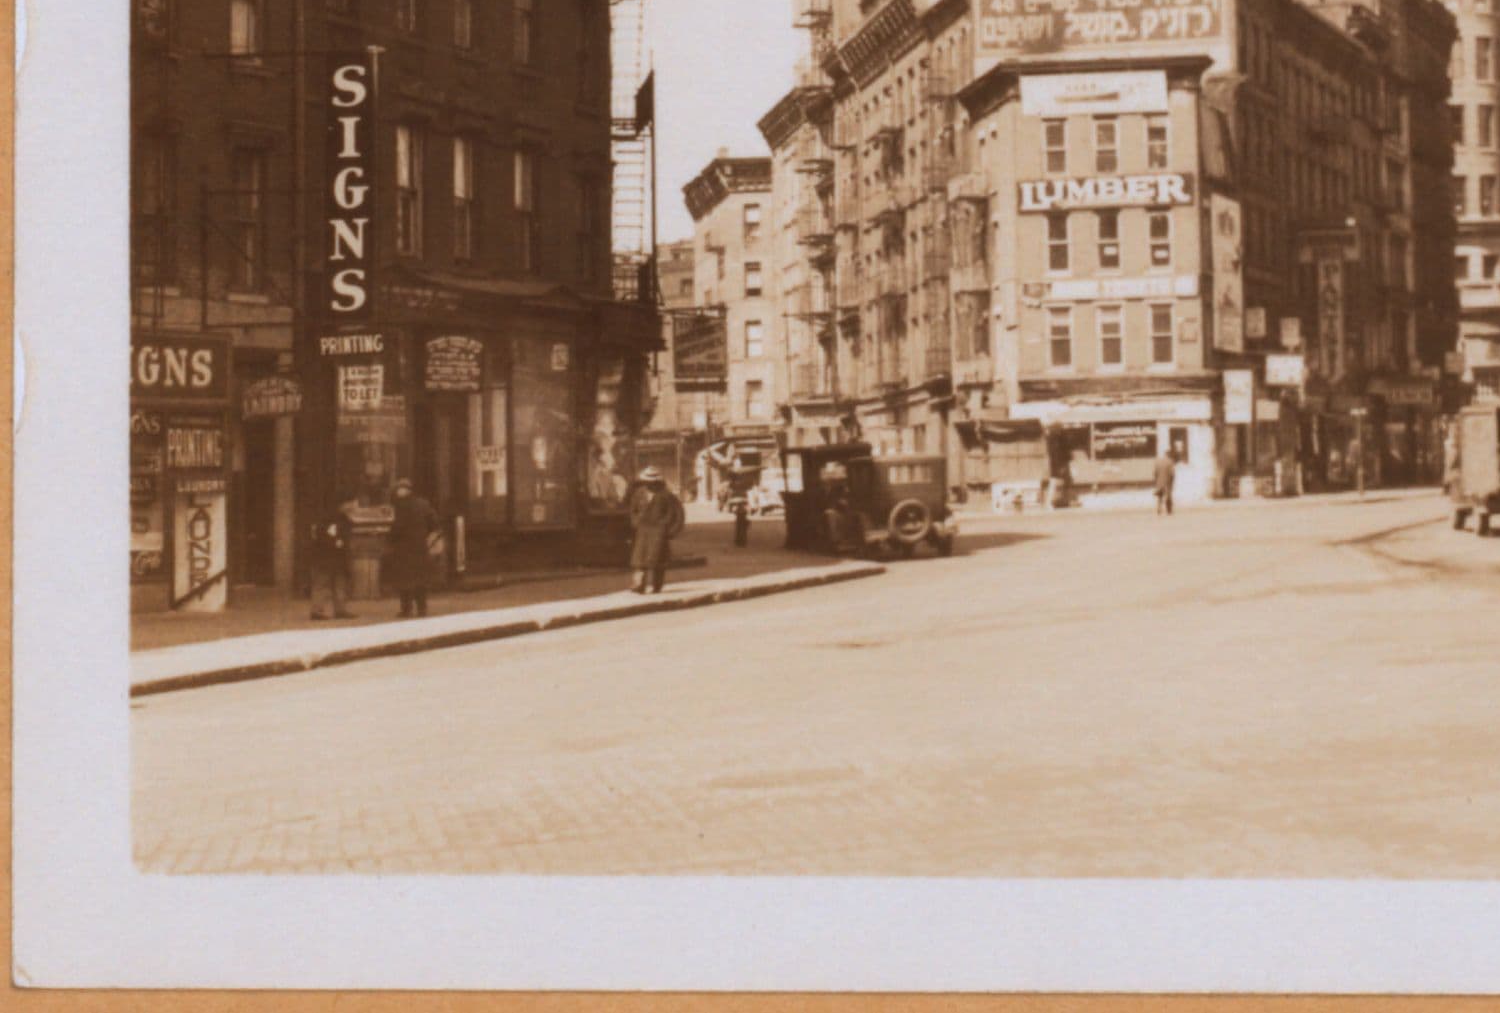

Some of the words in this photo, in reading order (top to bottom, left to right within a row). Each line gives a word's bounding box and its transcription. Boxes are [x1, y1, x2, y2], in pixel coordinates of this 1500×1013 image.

[330, 65, 369, 312] SIGNS
[1021, 174, 1189, 209] LUMBER
[320, 334, 384, 356] PRINTING
[131, 347, 212, 387] GNS
[168, 428, 223, 467] PRINTING
